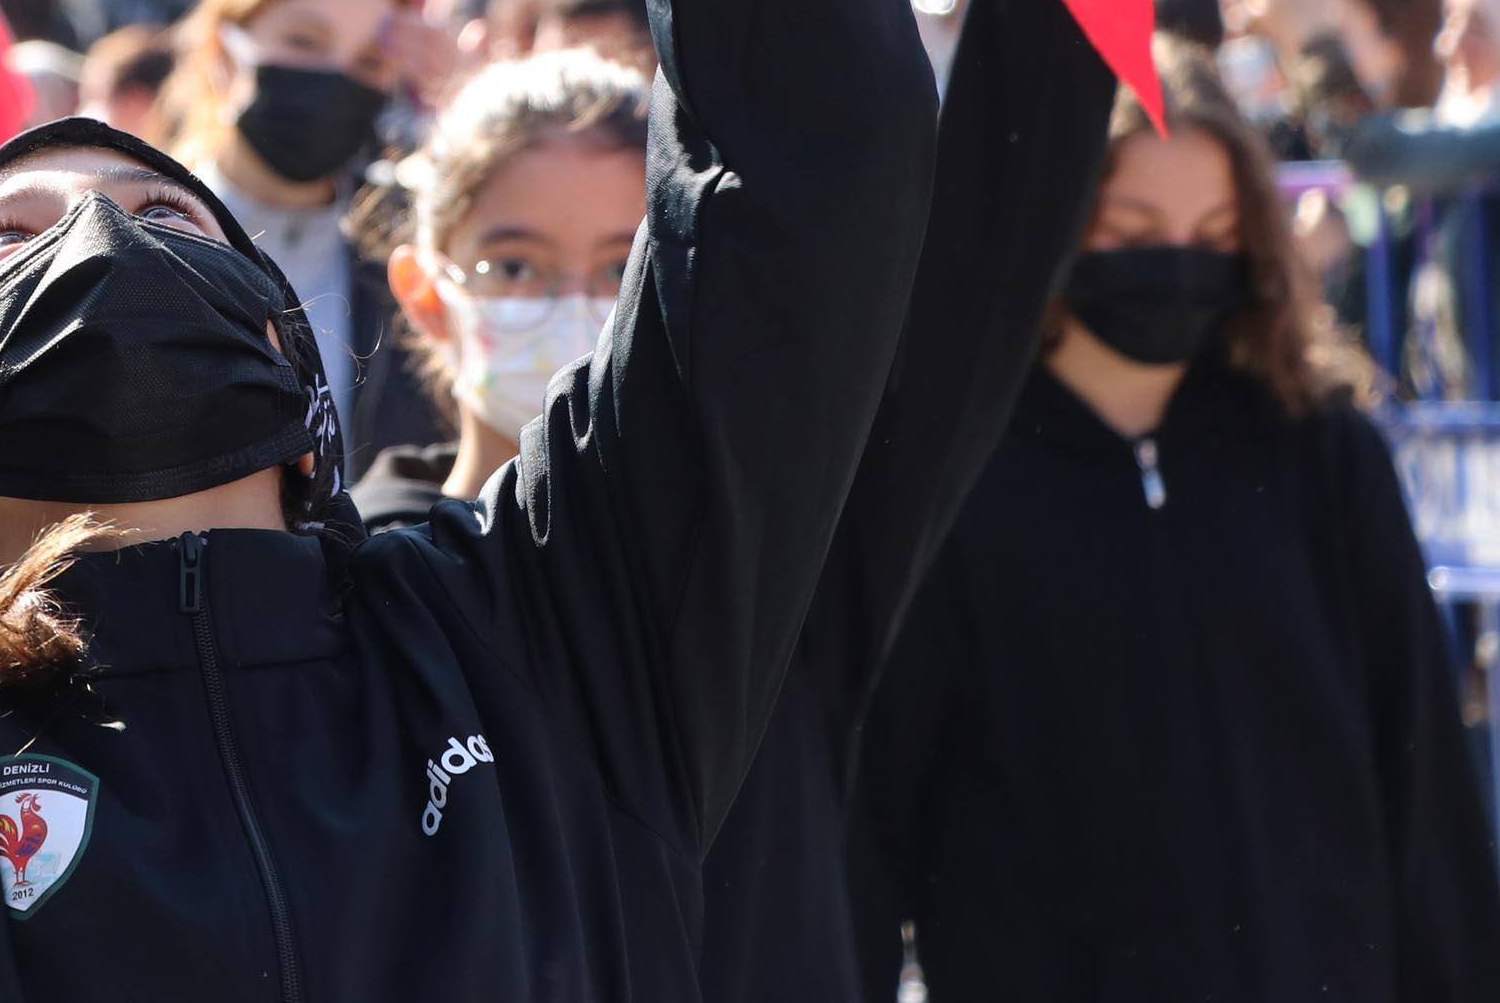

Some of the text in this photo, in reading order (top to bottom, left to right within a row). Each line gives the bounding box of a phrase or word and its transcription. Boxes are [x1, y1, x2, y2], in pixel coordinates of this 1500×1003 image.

[3, 763, 50, 776] DENİZLİ
[37, 777, 57, 785] SPOR
[12, 888, 34, 901] 2012
